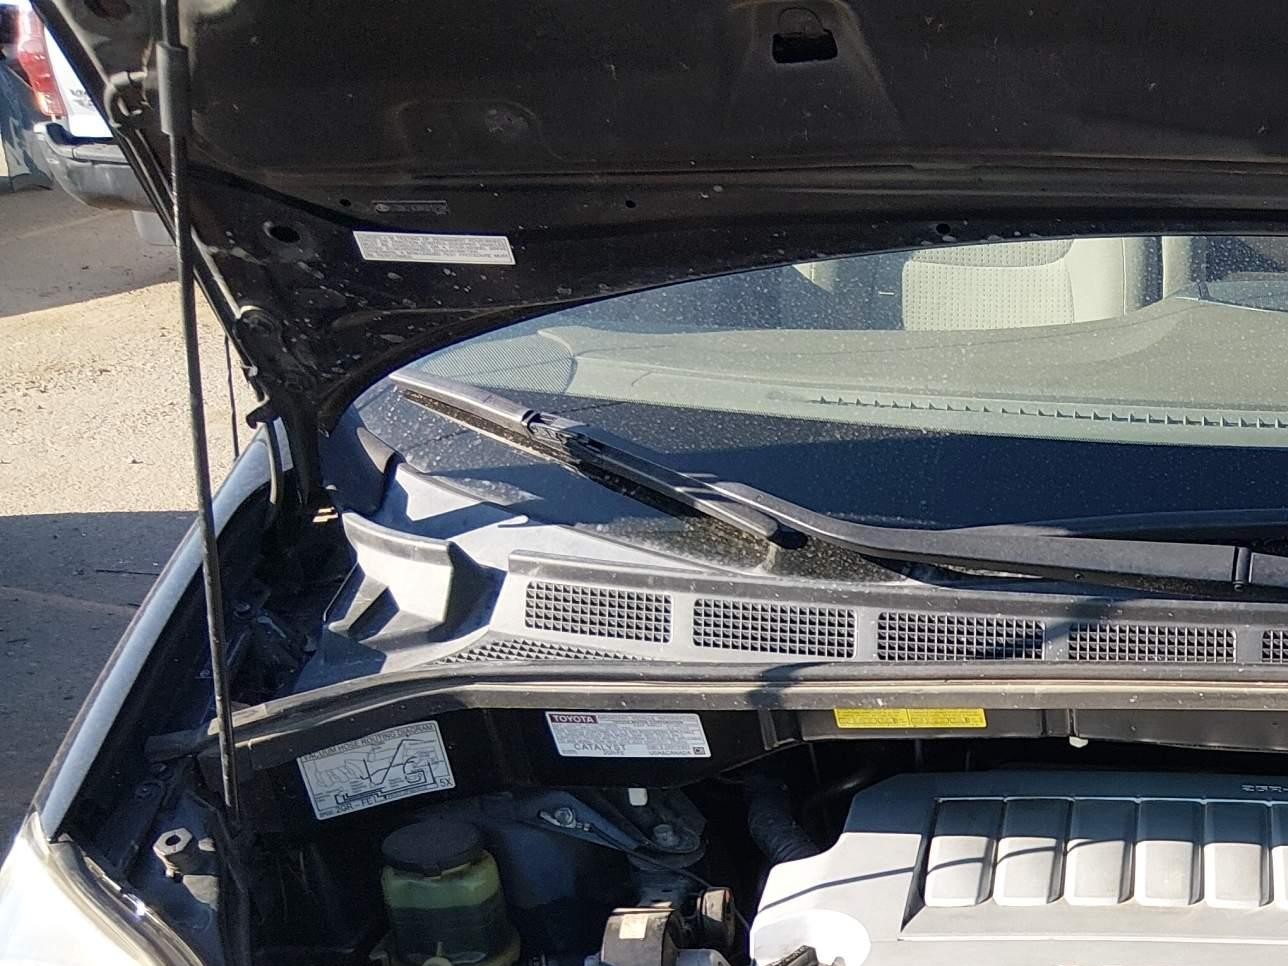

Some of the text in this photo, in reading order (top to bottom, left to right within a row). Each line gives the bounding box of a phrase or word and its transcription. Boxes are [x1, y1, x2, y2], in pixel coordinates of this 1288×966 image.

[552, 714, 595, 723] TOYOTA
[304, 724, 434, 761] VACUUM HOSE ROUTING DIAGRAM
[574, 743, 626, 751] CATALYST
[440, 778, 454, 788] 5X
